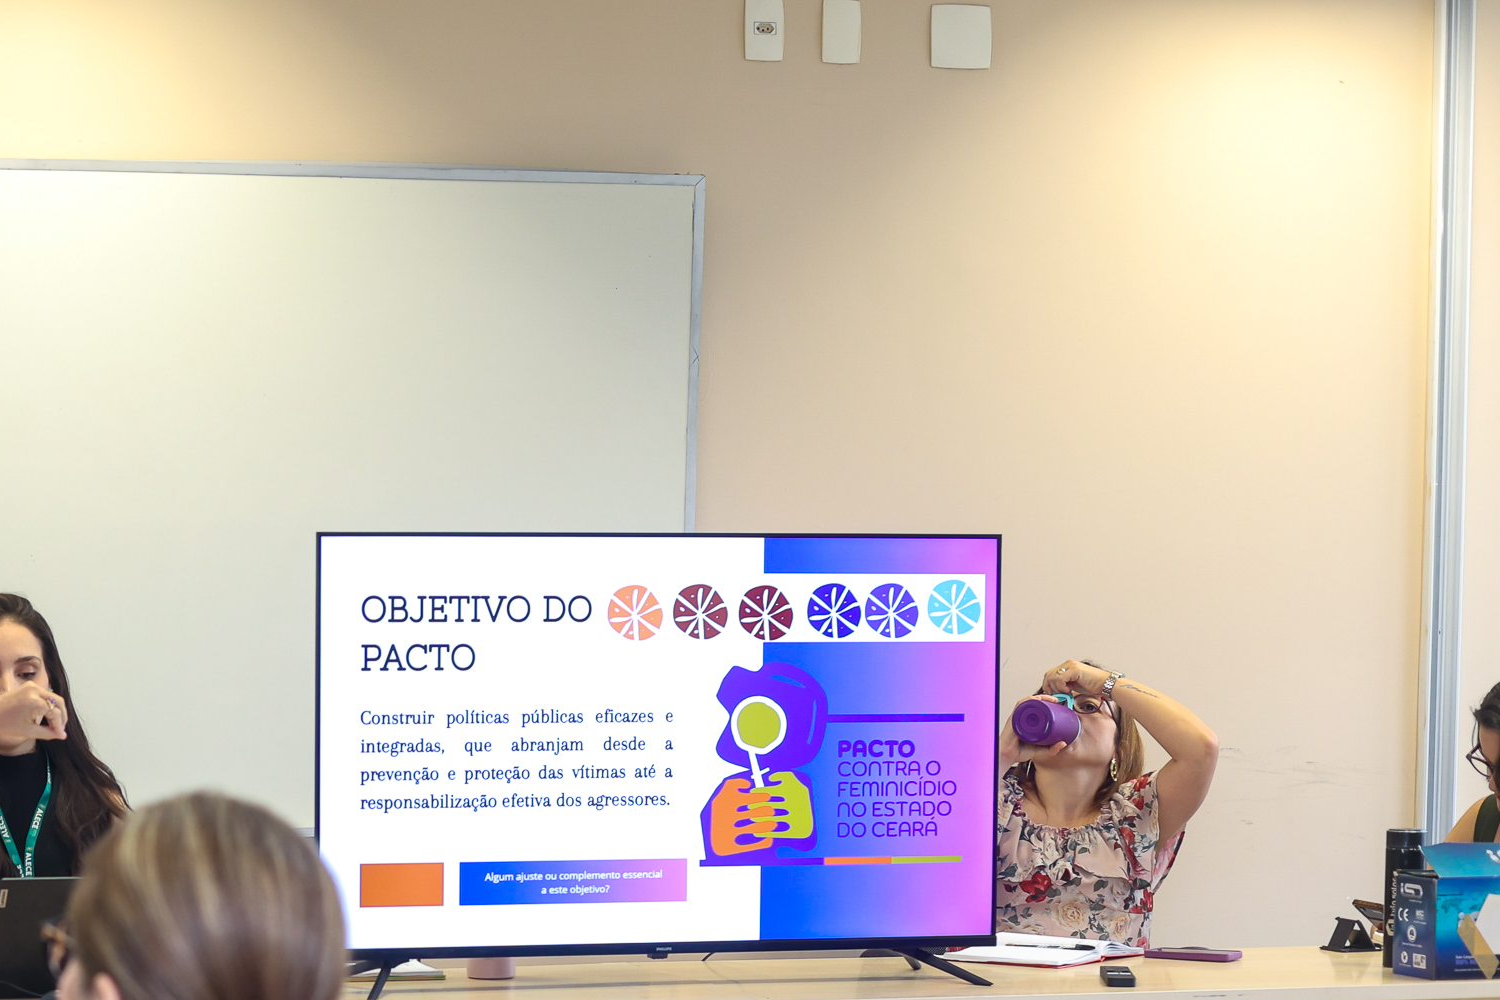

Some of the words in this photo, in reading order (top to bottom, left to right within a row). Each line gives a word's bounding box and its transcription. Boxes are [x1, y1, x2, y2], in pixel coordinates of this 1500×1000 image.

[361, 594, 531, 624] OBJETIVO
[542, 594, 593, 623] DO
[360, 643, 476, 672] PACTO
[360, 710, 435, 726] Construir
[446, 709, 510, 729] políticas
[521, 708, 584, 728] públicas
[595, 708, 654, 724] eficazes
[665, 711, 674, 723] e
[360, 737, 445, 758] integradas,
[464, 741, 492, 757] que
[511, 736, 584, 756] abranjam
[603, 735, 646, 751] desde
[664, 739, 674, 751] a
[837, 739, 916, 758] PACTO
[360, 766, 440, 786] prevenção
[447, 769, 456, 781] e
[464, 765, 531, 785] proteção
[538, 764, 564, 780] das
[572, 764, 626, 779] vítimas
[634, 763, 656, 779] até
[664, 767, 674, 778] a
[837, 760, 921, 777] CONTRA
[925, 760, 941, 776] O
[837, 776, 957, 798] FEMINICÍDIO
[360, 793, 498, 814] responsabilização
[501, 792, 552, 808] efetiva
[556, 792, 582, 807] dos
[587, 794, 670, 811] agressores.
[837, 801, 867, 818] NO
[872, 800, 952, 818] ESTADO
[31, 807, 44, 830] ALECE
[837, 821, 867, 838] DO
[871, 816, 938, 837] CEARÁ
[25, 852, 33, 876] ALECE
[484, 872, 514, 884] Algum
[515, 871, 544, 883] ajuste
[544, 873, 558, 881] ou
[558, 870, 621, 882] complemento
[622, 869, 663, 880] essencial
[540, 886, 547, 895] a
[548, 885, 568, 895] este
[569, 884, 610, 896] objetivo?
